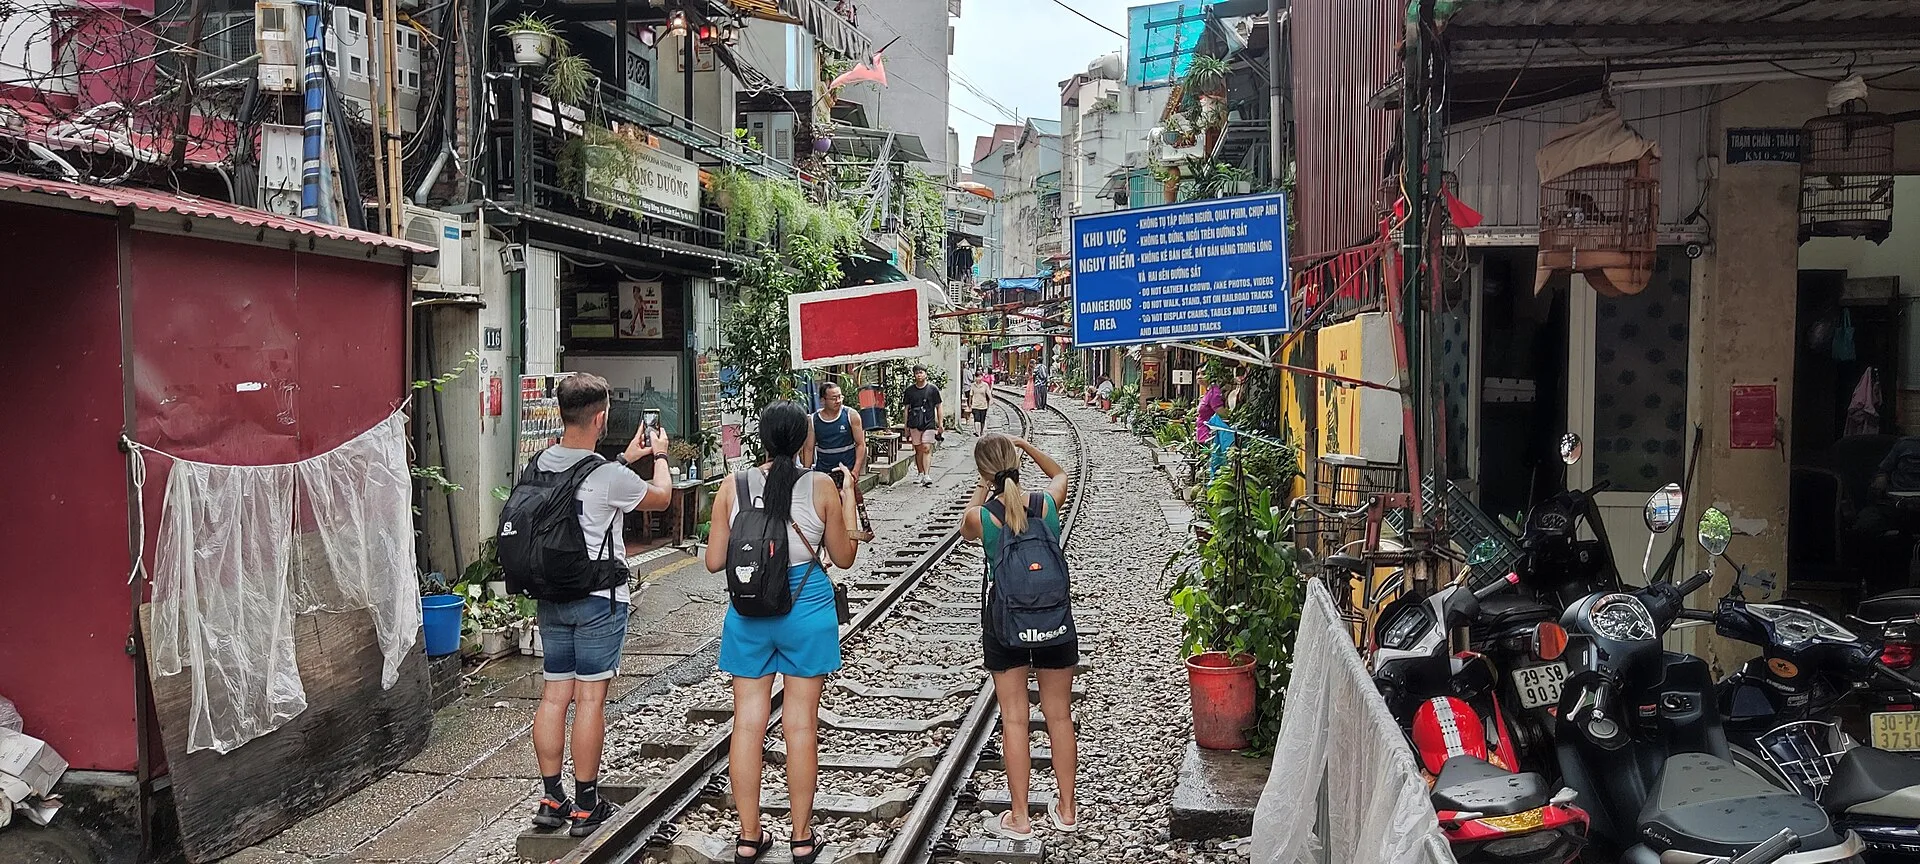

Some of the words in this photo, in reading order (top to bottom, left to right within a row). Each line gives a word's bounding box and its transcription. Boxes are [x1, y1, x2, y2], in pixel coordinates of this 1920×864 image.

[1732, 135, 1750, 149] TRẠM
[1746, 152, 1761, 160] KM
[1780, 151, 1795, 160] 790
[657, 173, 688, 198] DƯƠNG
[1140, 216, 1158, 229] KHÔNG
[1159, 217, 1166, 229] TỤ
[1167, 213, 1177, 228] TẬP
[1215, 209, 1230, 222] QUAY
[1231, 207, 1248, 220] PHIM,
[1248, 206, 1264, 219] CHỤP
[1265, 201, 1278, 216] ẢNH
[1082, 231, 1104, 248] KHU
[1106, 228, 1127, 248] VỰC
[1140, 233, 1159, 246] KHÔNG
[1201, 227, 1215, 239] TRÊN
[1237, 222, 1248, 236] SẮT
[1141, 250, 1159, 263] KHÔNG
[1220, 242, 1236, 255] HÀNG
[1237, 242, 1256, 254] TRONG
[1257, 238, 1272, 252] LÒNG
[1080, 256, 1106, 274] NGUY
[1109, 248, 1135, 270] HIỂM
[1138, 268, 1146, 282] VÀ
[1148, 270, 1158, 282] HAI
[1158, 267, 1170, 280] BÊN
[1190, 264, 1201, 278] SẮT
[1142, 288, 1150, 297] DO
[1150, 286, 1161, 296] NOT
[1162, 284, 1183, 295] GATHER
[1184, 283, 1189, 292] A
[1190, 282, 1212, 292] CROWD,
[1214, 280, 1227, 290] TAKE
[1228, 278, 1252, 289] PHOTOS,
[1253, 276, 1273, 286] VIDEOS
[1080, 298, 1132, 314] DANGEROUS
[1142, 301, 1150, 310] DO
[1151, 300, 1162, 309] NOT
[1162, 298, 1180, 308] WALK,
[1182, 296, 1202, 306] STAND,
[1202, 295, 1212, 304] SIT
[1212, 294, 1221, 303] ON
[1222, 292, 1249, 302] RAILROAD
[1250, 290, 1273, 300] TRACKS
[1142, 314, 1150, 323] DO
[1151, 313, 1162, 322] NOT
[1164, 311, 1186, 320] DISPLAY
[1187, 309, 1210, 319] CHAIRS,
[1210, 307, 1231, 317] TABLES
[1232, 306, 1244, 315] AND
[1246, 304, 1267, 314] PEDDLE
[1268, 304, 1277, 312] ON
[1094, 318, 1116, 331] AREA
[1140, 327, 1151, 336] AND
[1152, 325, 1171, 335] ALONG
[1171, 323, 1198, 333] RAILROAD
[1200, 321, 1221, 331] TRACKS
[487, 331, 500, 346] 116
[1018, 625, 1067, 642] ellesse
